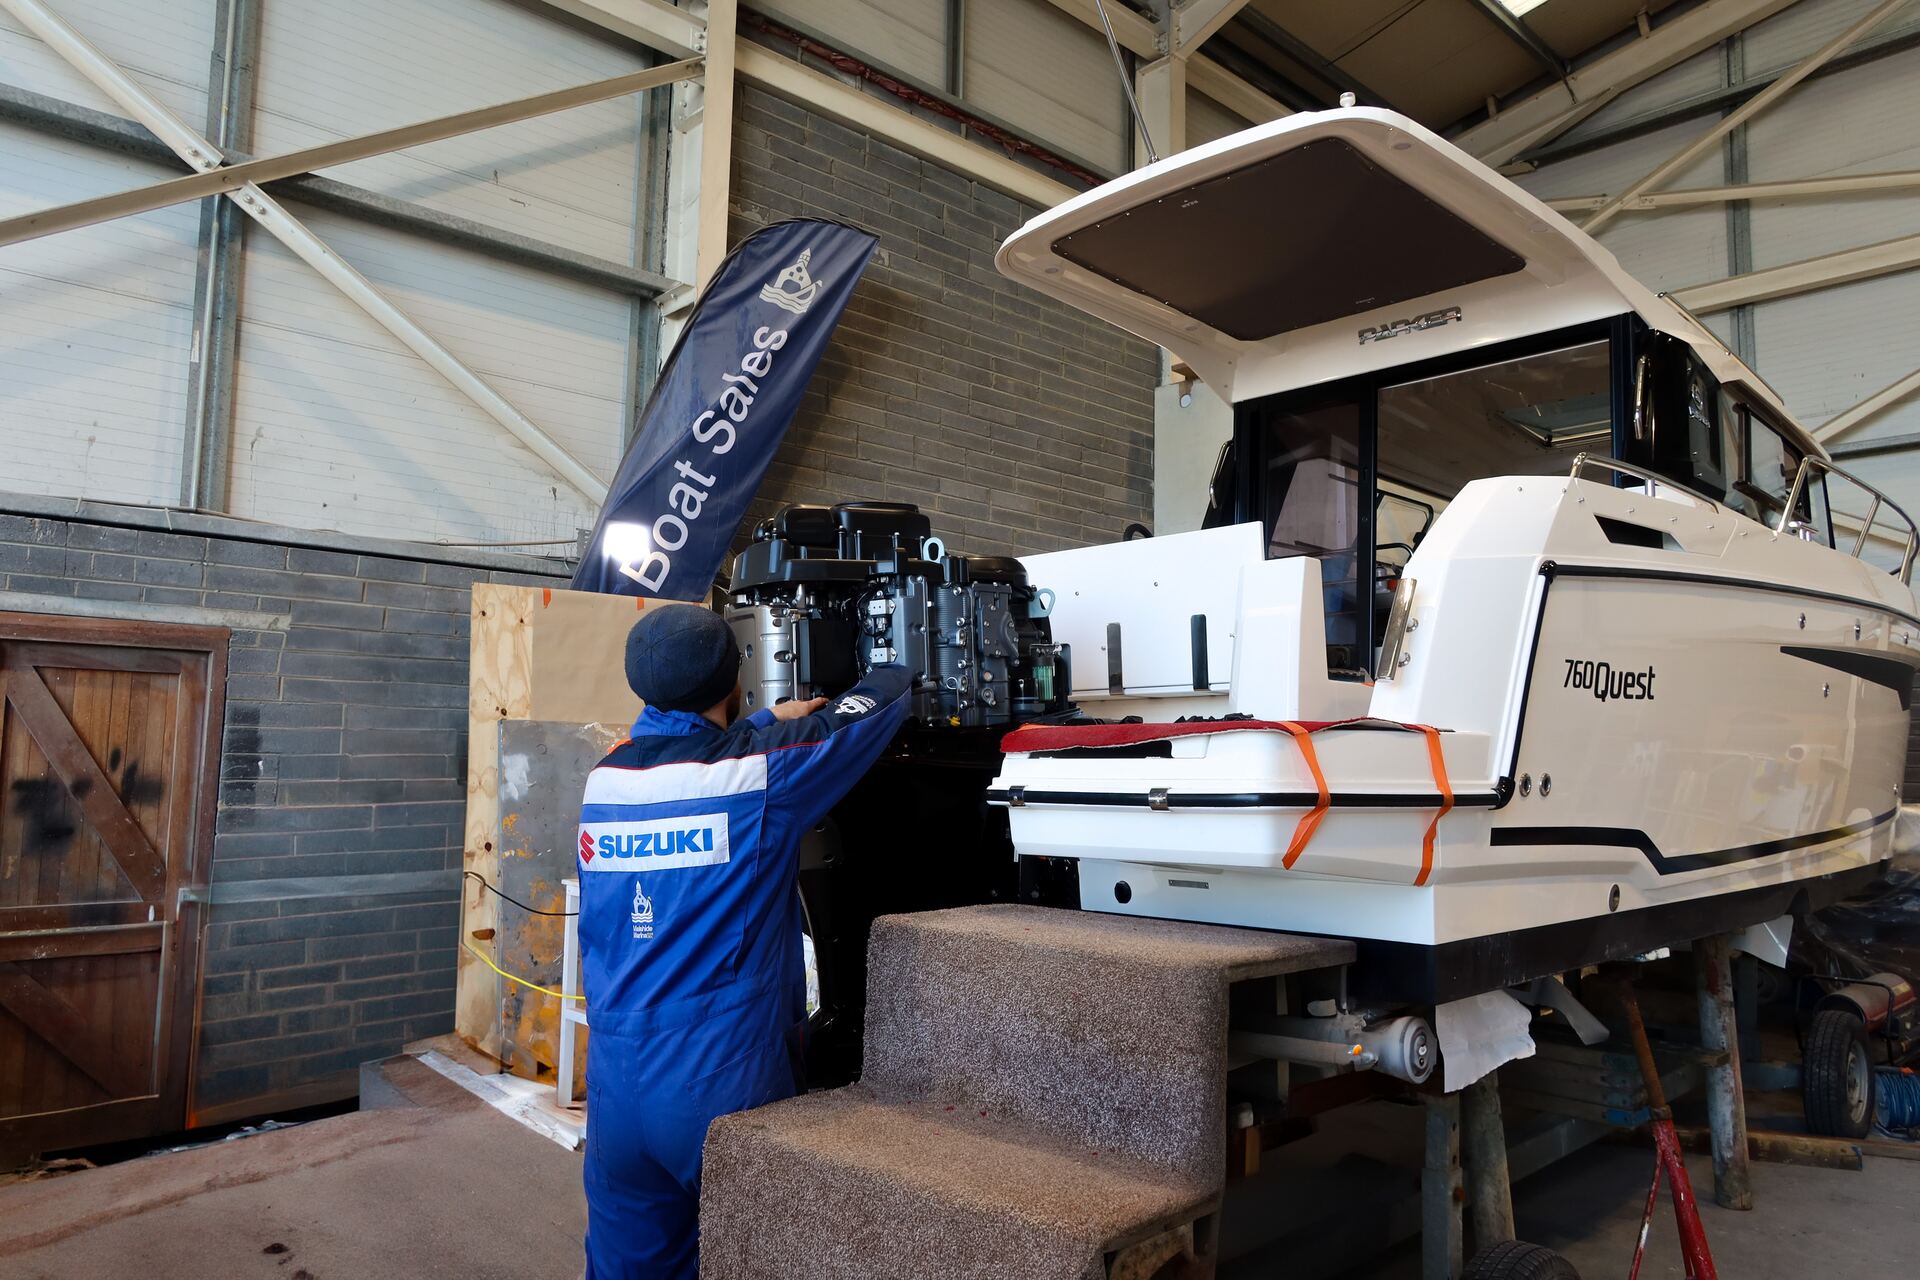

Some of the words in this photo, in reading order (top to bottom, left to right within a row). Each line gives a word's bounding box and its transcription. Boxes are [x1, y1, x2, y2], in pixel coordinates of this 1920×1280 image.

[1358, 306, 1462, 345] PARKER
[618, 460, 717, 593] Boat
[692, 326, 788, 455] Sales
[599, 827, 714, 859] SUZUKI
